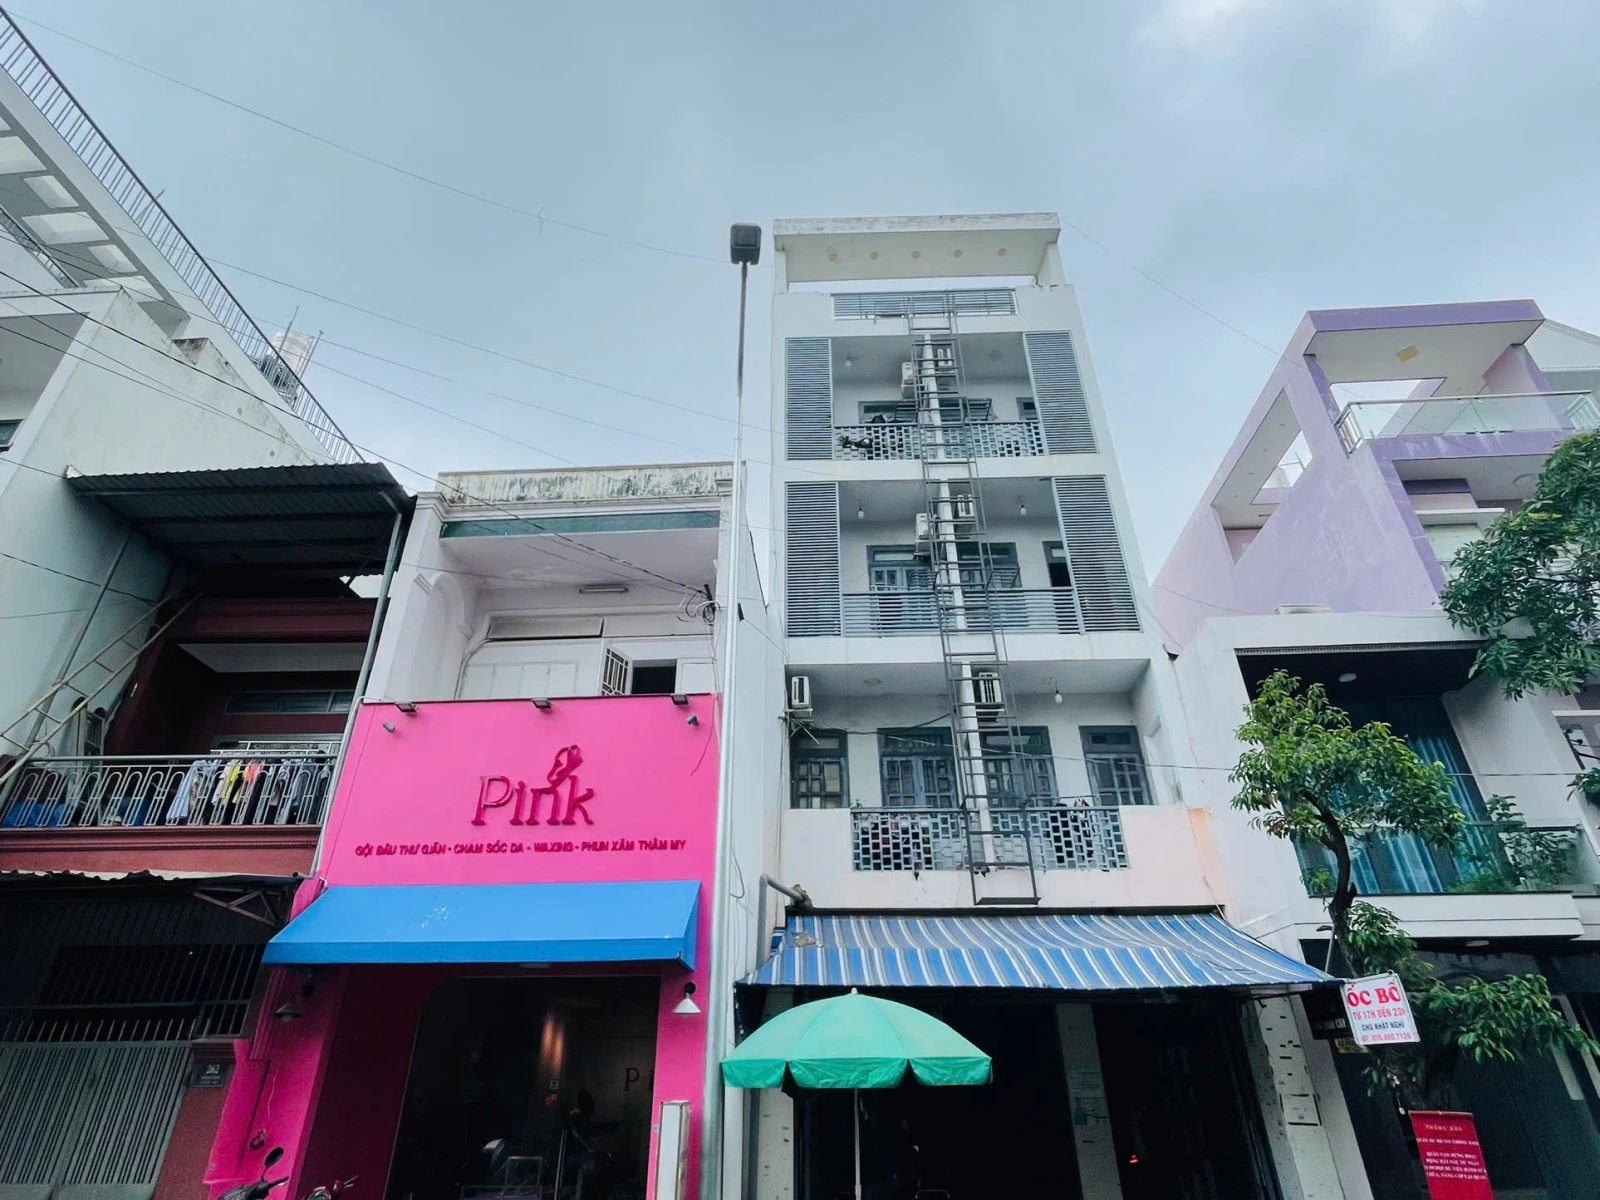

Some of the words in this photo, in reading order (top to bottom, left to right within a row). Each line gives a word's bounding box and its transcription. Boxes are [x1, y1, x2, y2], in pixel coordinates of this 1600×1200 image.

[471, 773, 594, 826] Pink
[486, 840, 507, 854] SÓC
[510, 842, 524, 854] DA
[581, 841, 609, 852] PHUN
[1346, 984, 1372, 1007] ỐC
